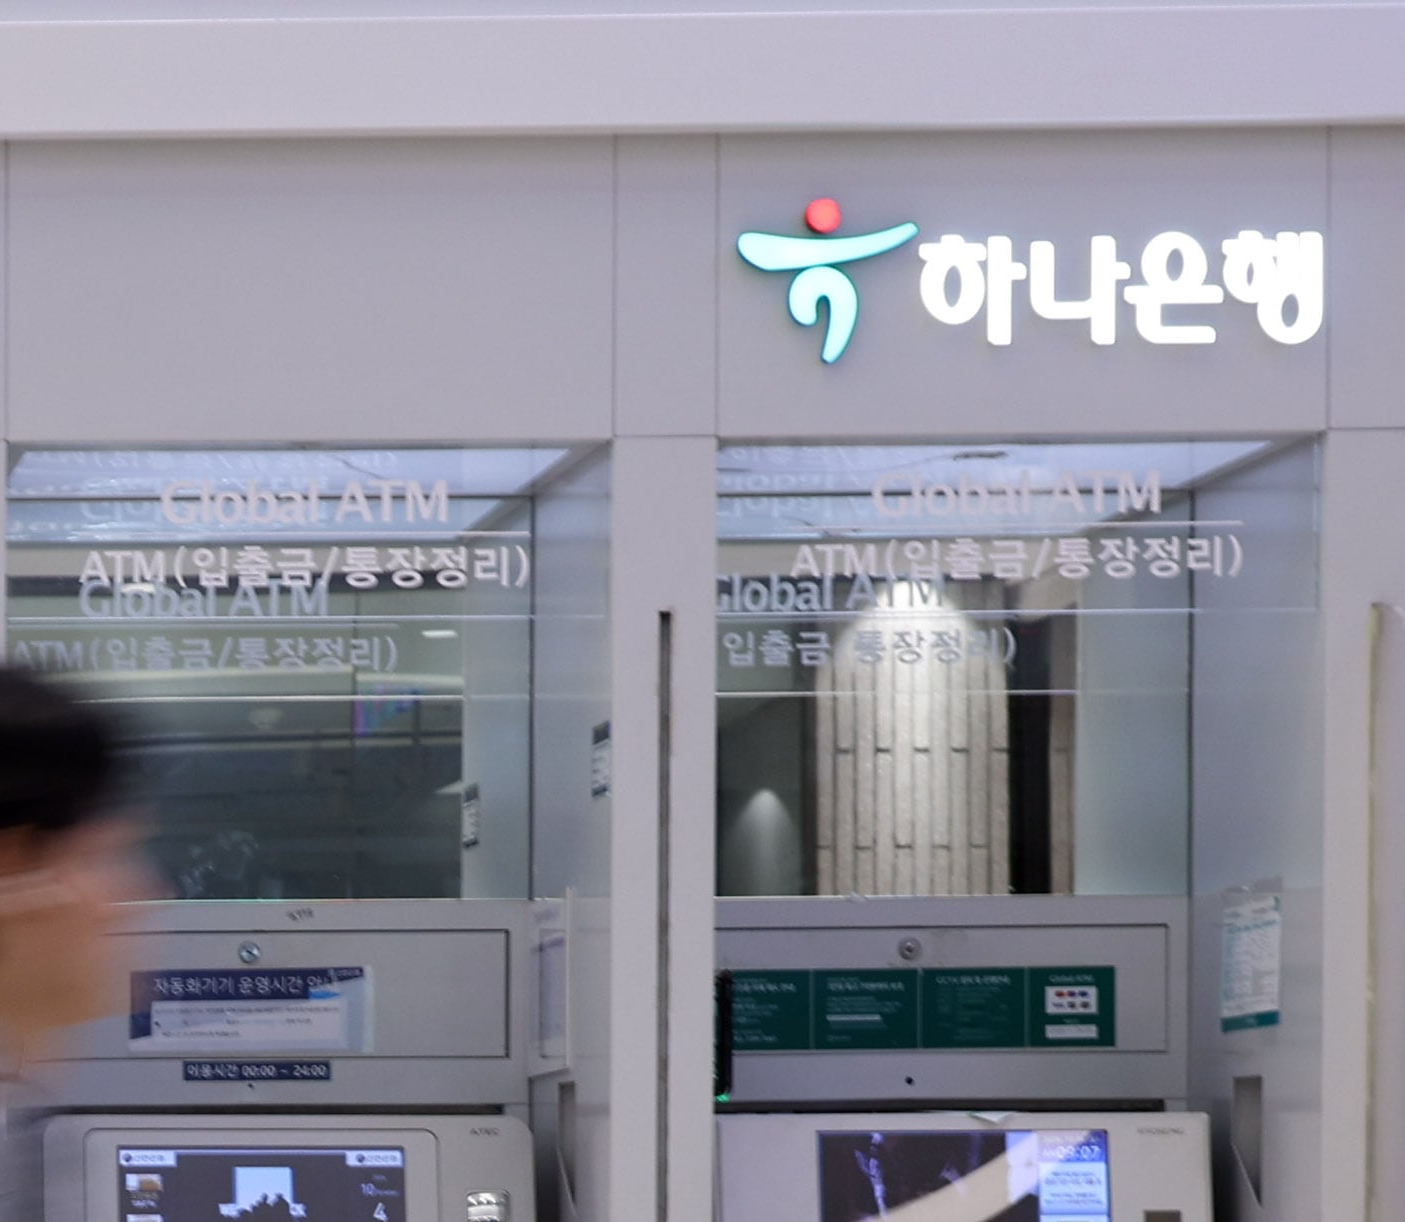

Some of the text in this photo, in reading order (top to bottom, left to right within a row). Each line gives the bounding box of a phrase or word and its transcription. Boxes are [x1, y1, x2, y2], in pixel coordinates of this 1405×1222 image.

[918, 230, 1325, 347] 하나은행
[161, 480, 450, 524] Global ATM
[871, 474, 1033, 516] Global
[1049, 470, 1162, 513] ATM
[80, 546, 532, 588] ATM(입출금/통장정리)
[790, 534, 1244, 579] ATM(입출금/통장정리)
[79, 578, 329, 618] Global ATM
[154, 977, 234, 995] 자동화기기
[237, 976, 303, 995] 운영시간
[241, 1065, 276, 1077] 00:00
[1056, 1145, 1100, 1159] 09:07
